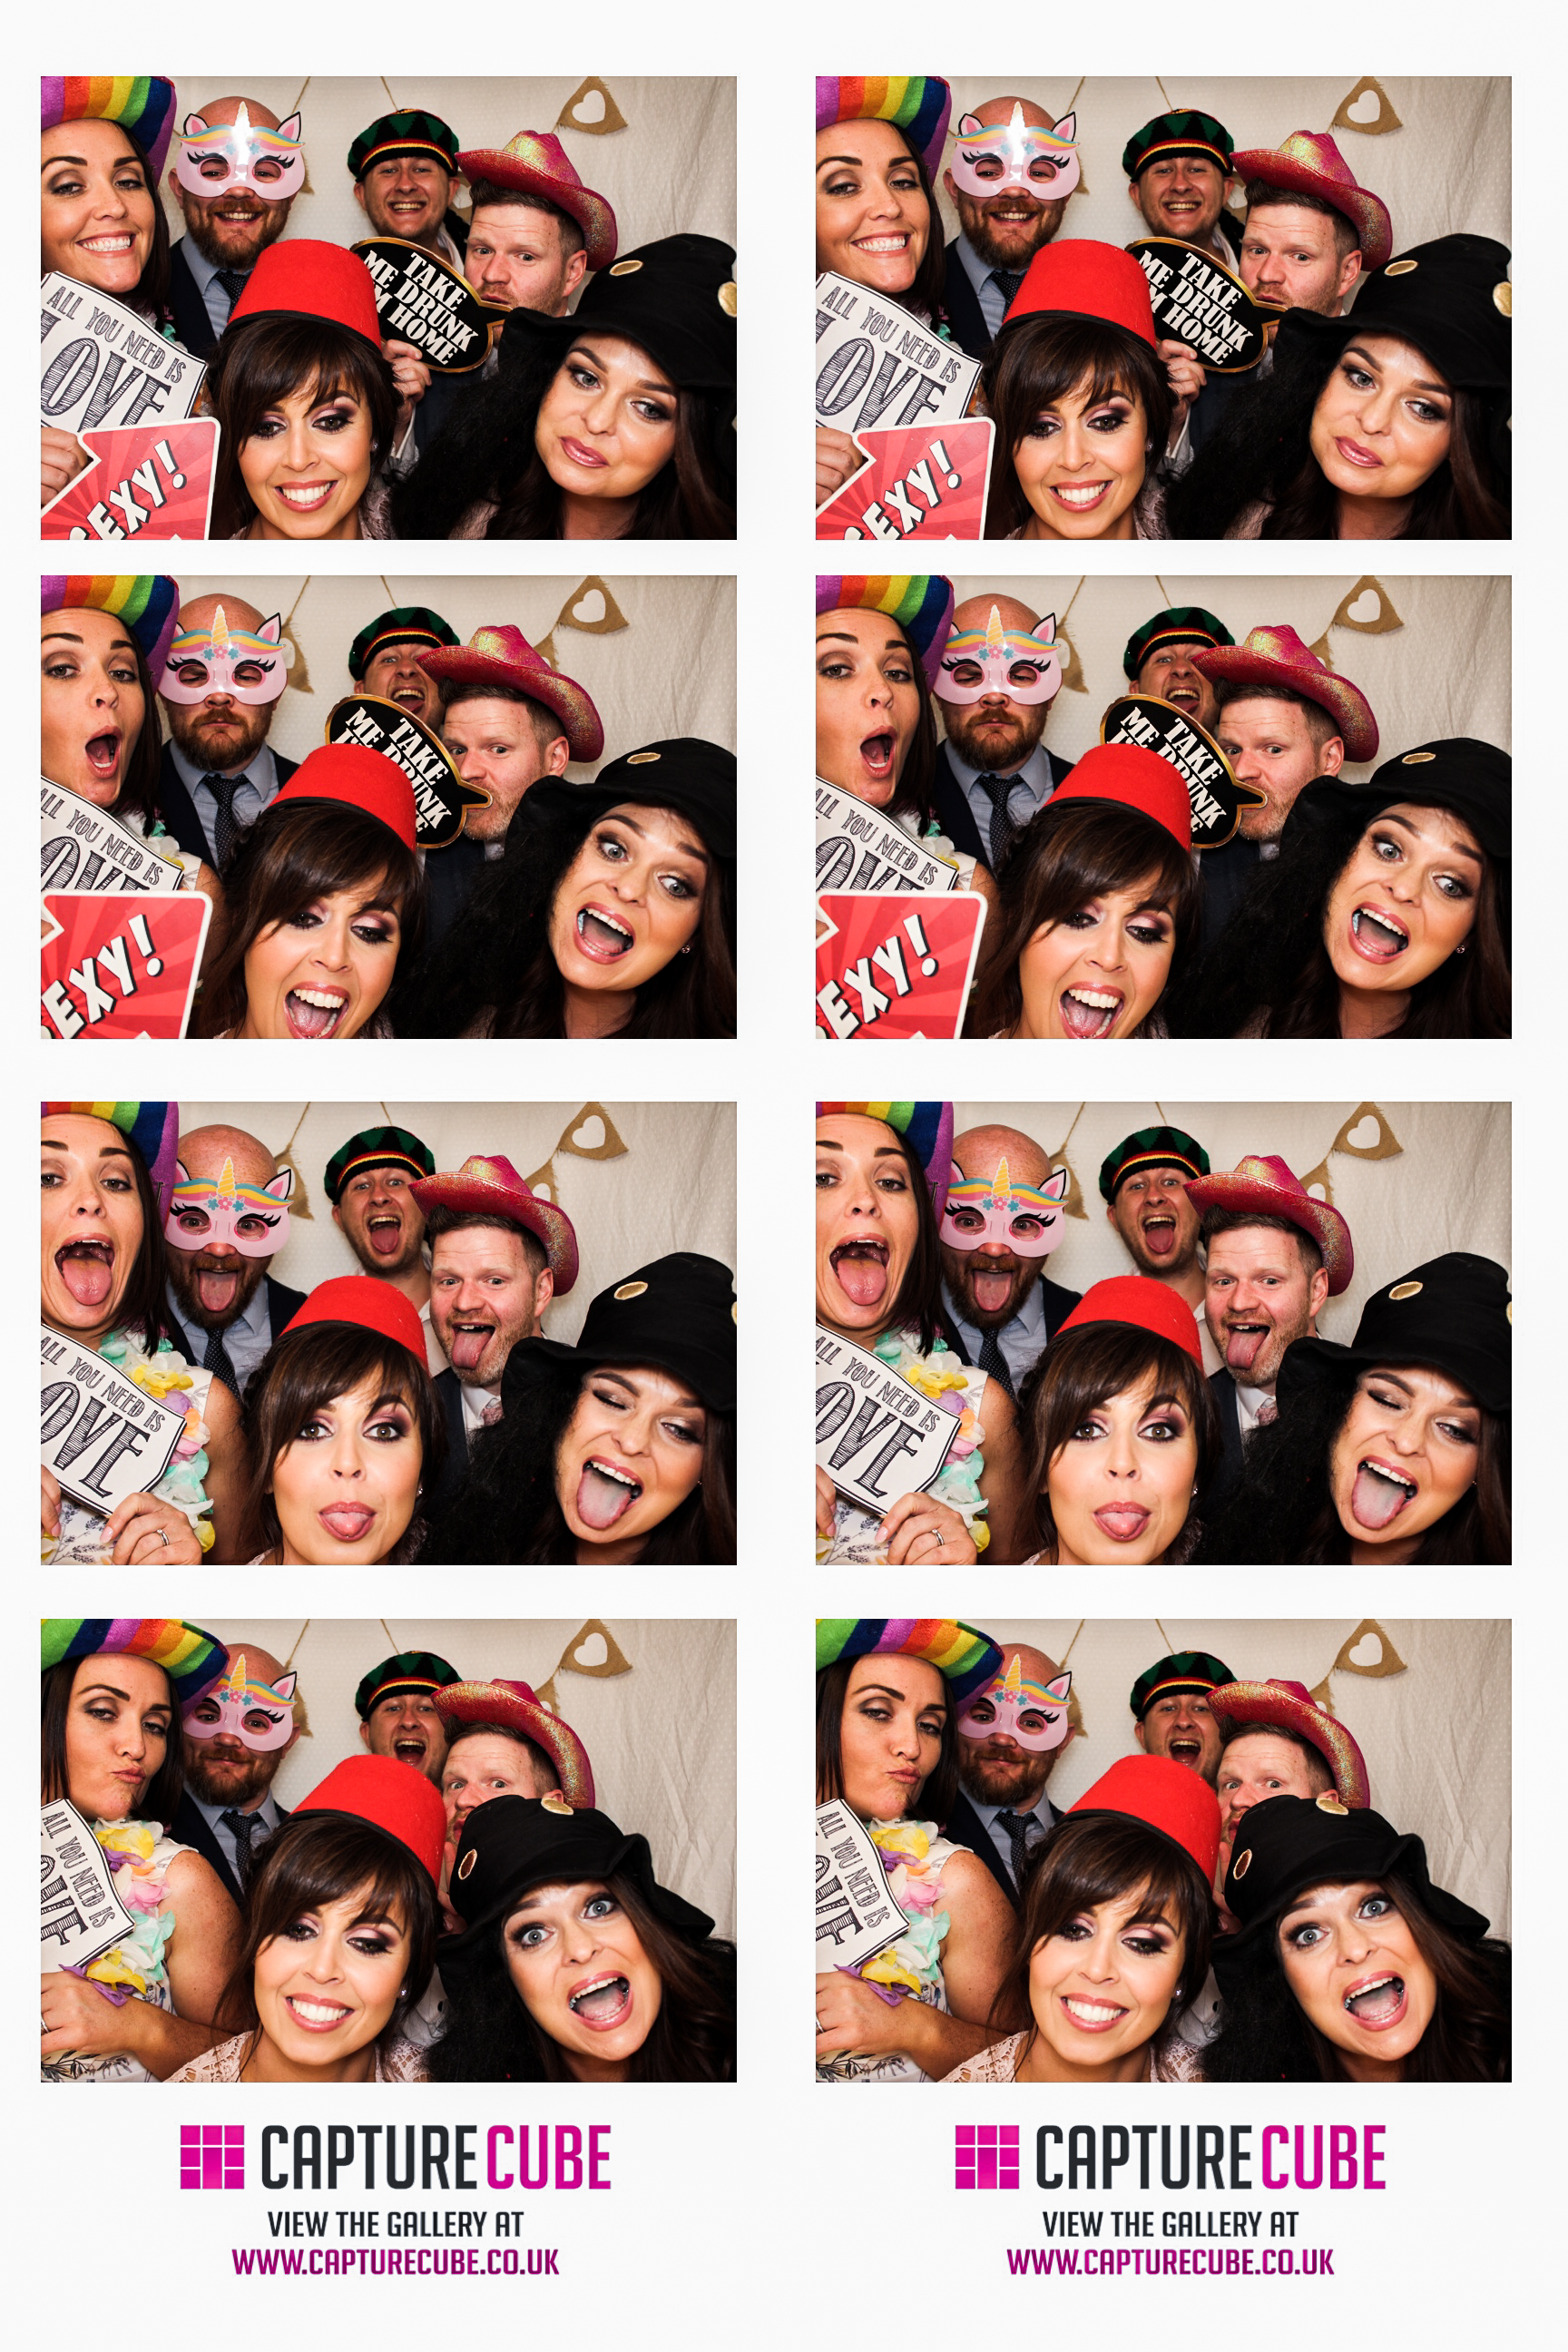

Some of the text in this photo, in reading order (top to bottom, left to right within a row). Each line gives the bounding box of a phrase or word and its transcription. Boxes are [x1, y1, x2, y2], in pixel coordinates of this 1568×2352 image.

[394, 278, 478, 352] DRUNK
[403, 252, 467, 312] TAKE
[1169, 278, 1253, 352] DRUNK
[1178, 252, 1242, 312] TAKE
[47, 286, 187, 383] ALL YOU NEED IS
[387, 302, 459, 365] HOME
[822, 286, 962, 383] ALL YOU NEED IS
[1162, 302, 1234, 365] HOME
[69, 439, 187, 539] EXY!
[844, 439, 962, 539] EXY!
[345, 707, 385, 748] ME
[388, 717, 448, 786] TAKE
[1120, 707, 1160, 748] ME
[1163, 717, 1223, 786] TAKE
[66, 808, 103, 843] YOU
[100, 834, 144, 871] NEED
[142, 862, 163, 886] IS
[841, 808, 878, 843] YOU
[875, 834, 919, 871] NEED
[917, 862, 938, 886] IS
[41, 914, 164, 1039] EXY!
[816, 914, 939, 1039] EXY!
[41, 1336, 165, 1433] ALL YOU NEED IS
[816, 1336, 940, 1433] ALL YOU NEED IS
[41, 1381, 151, 1498] OVE
[816, 1381, 926, 1498] OVE
[42, 1811, 72, 1839] ALL
[55, 1836, 88, 1869] YOU
[817, 1811, 847, 1839] ALL
[830, 1836, 863, 1869] YOU
[69, 1867, 106, 1907] NEED
[88, 1906, 115, 1928] IS
[844, 1867, 881, 1907] NEED
[863, 1906, 890, 1928] IS
